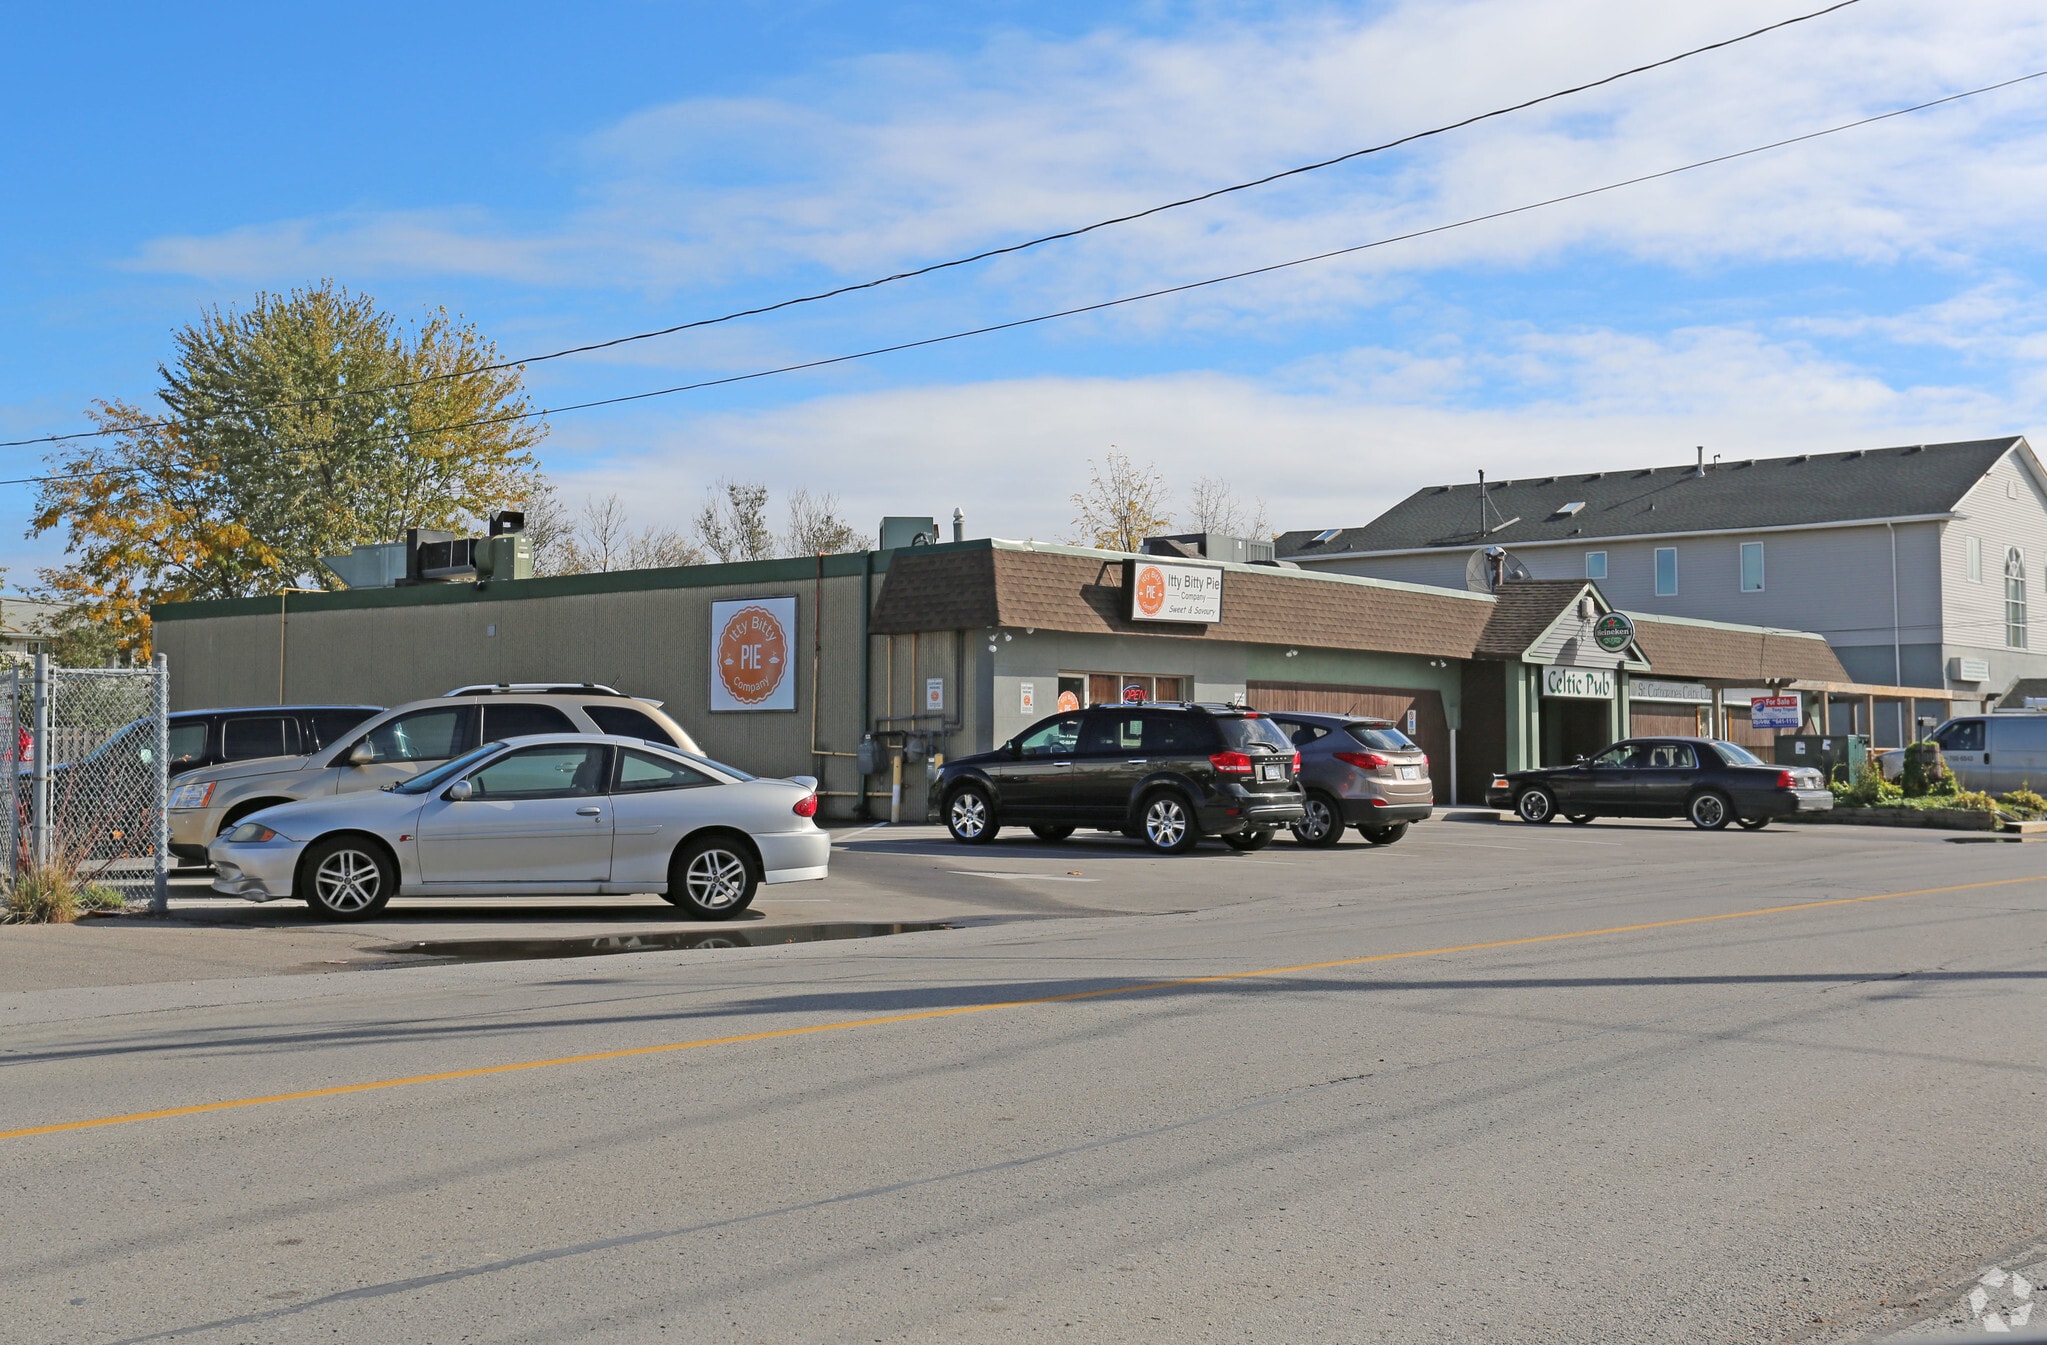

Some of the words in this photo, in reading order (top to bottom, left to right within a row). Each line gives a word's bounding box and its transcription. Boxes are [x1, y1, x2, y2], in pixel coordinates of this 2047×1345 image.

[1168, 573, 1181, 590] Itty
[1184, 575, 1203, 591] Bitty
[1206, 577, 1220, 590] Pie
[1146, 585, 1156, 599] PIE
[1180, 592, 1206, 602] Company
[1169, 605, 1186, 614] Sweet
[1188, 606, 1192, 614] &
[1194, 606, 1216, 616] Savoury
[729, 621, 748, 642] Itty
[752, 616, 776, 642] Bitty
[741, 644, 762, 670] PIE
[733, 676, 770, 694] Company
[1548, 669, 1582, 694] Celtic
[1586, 671, 1610, 696] Pub
[1124, 689, 1146, 700] OPEN
[1766, 698, 1776, 706] For
[1777, 698, 1790, 706] Sale
